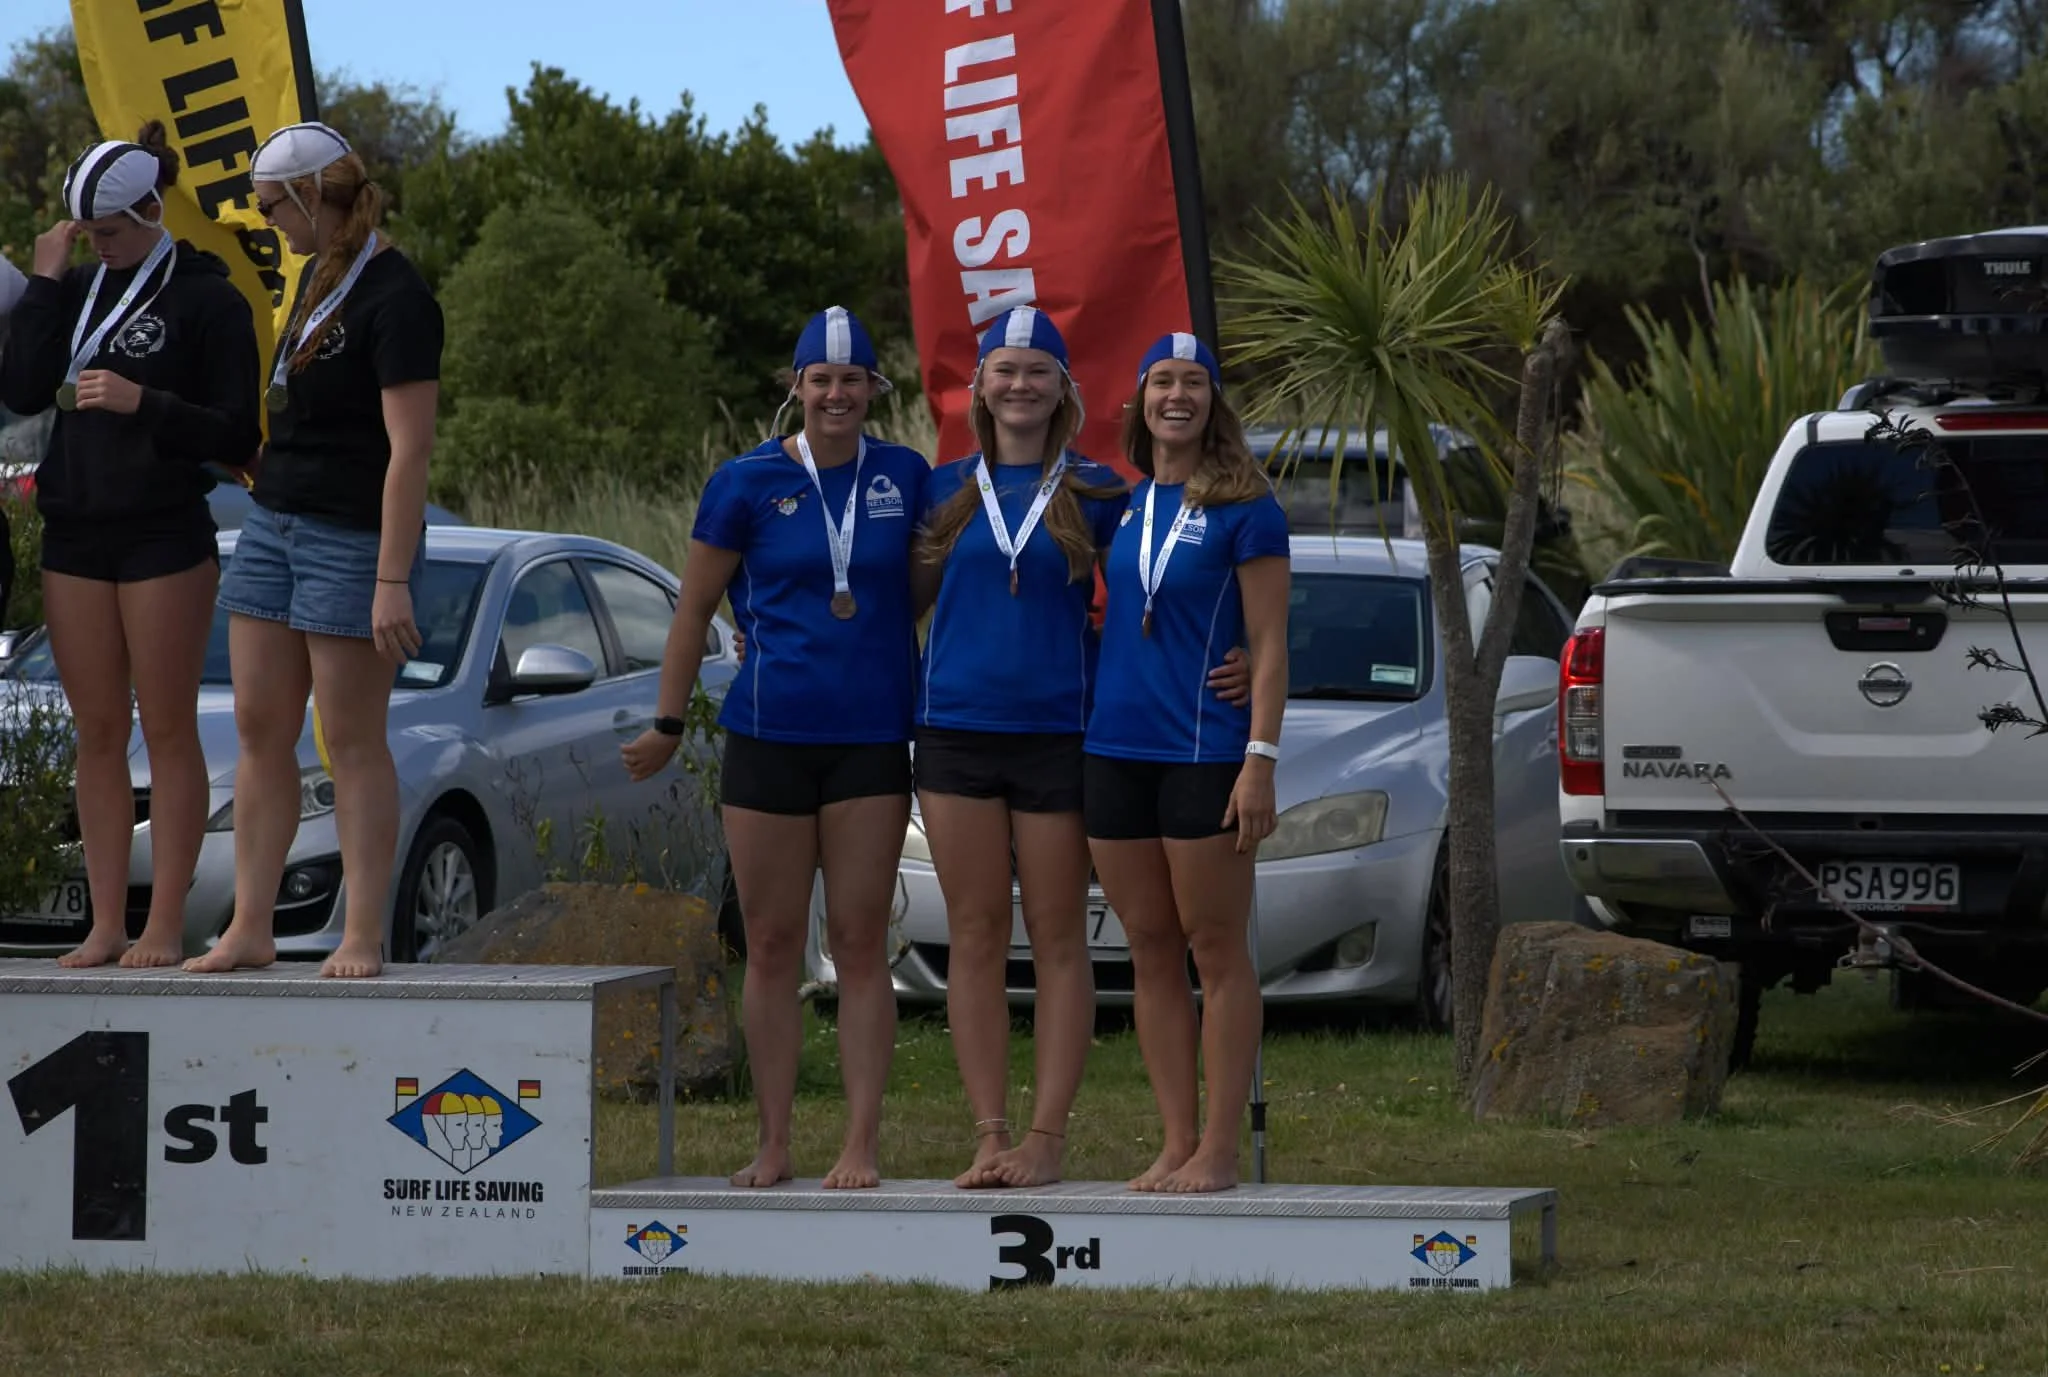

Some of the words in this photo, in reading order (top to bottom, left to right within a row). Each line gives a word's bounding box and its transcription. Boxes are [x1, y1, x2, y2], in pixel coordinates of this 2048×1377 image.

[944, 33, 1025, 199] LIFE
[162, 57, 257, 221] LIFE
[953, 208, 1037, 346] SA
[1983, 261, 2031, 275] THULE
[867, 498, 903, 507] NELSON
[1181, 523, 1206, 536] LSON
[1622, 762, 1732, 779] NAVARA
[1822, 866, 1954, 901] PSA996
[7, 1030, 269, 1241] 1st
[383, 1179, 432, 1200] SURF
[435, 1180, 471, 1201] LIFE
[475, 1181, 544, 1203] SAVING
[391, 1205, 433, 1217] NEW
[441, 1206, 535, 1219] ZEALAND
[989, 1214, 1100, 1292] 3rd
[623, 1266, 642, 1276] SURF
[1409, 1277, 1430, 1287] SURF
[1432, 1278, 1447, 1288] LIFE
[1449, 1278, 1479, 1288] SAVING
